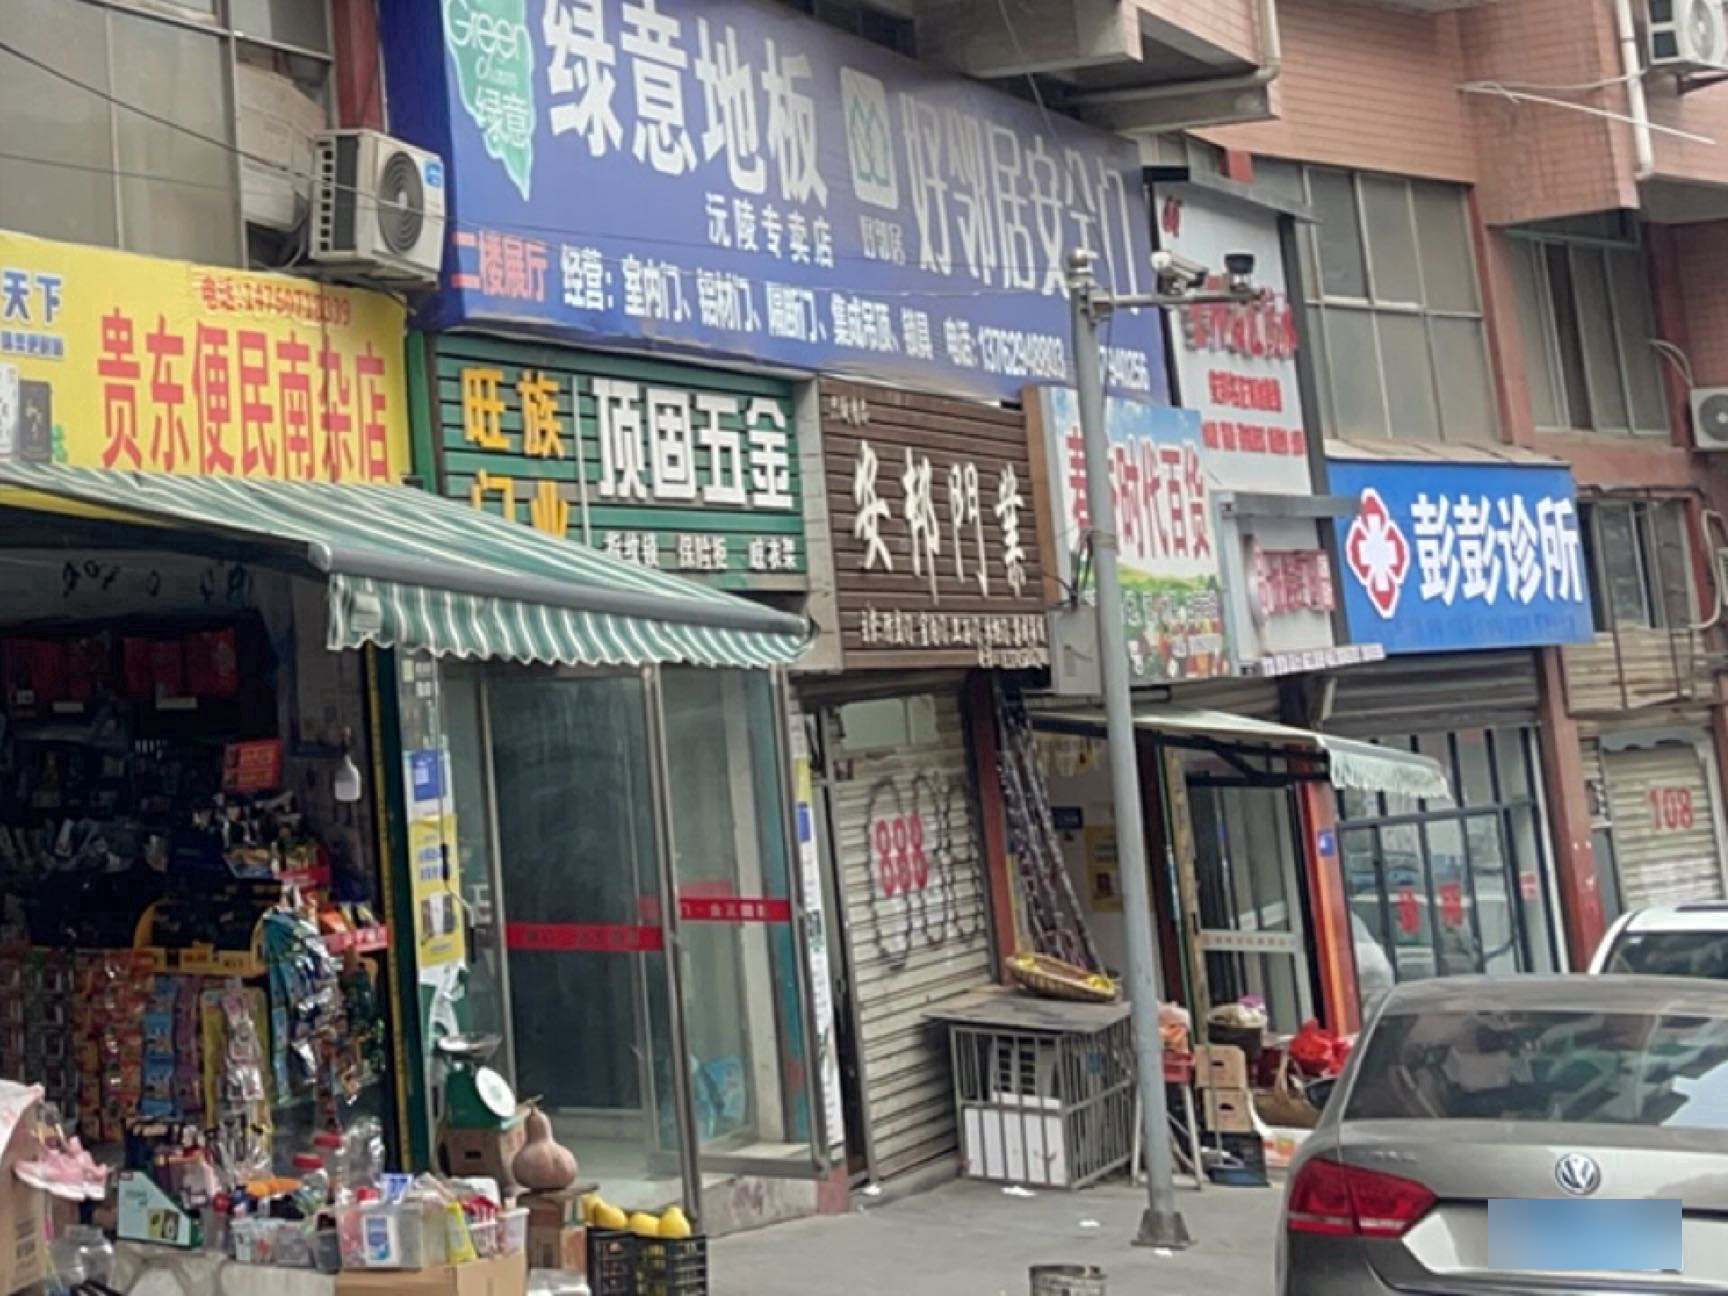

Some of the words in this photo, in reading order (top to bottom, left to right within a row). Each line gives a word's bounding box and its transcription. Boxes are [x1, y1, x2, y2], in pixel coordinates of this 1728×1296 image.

[474, 85, 531, 148] 绿意
[450, 231, 548, 302] 二楼展厅
[706, 193, 834, 269] 沅陵专卖店
[98, 307, 388, 483] 贵东便民南杂店
[460, 365, 566, 459] 旺族
[591, 376, 793, 510] 顶固五金
[1065, 427, 1212, 560] 春时代百货
[1409, 493, 1584, 606] 彭彭诊所
